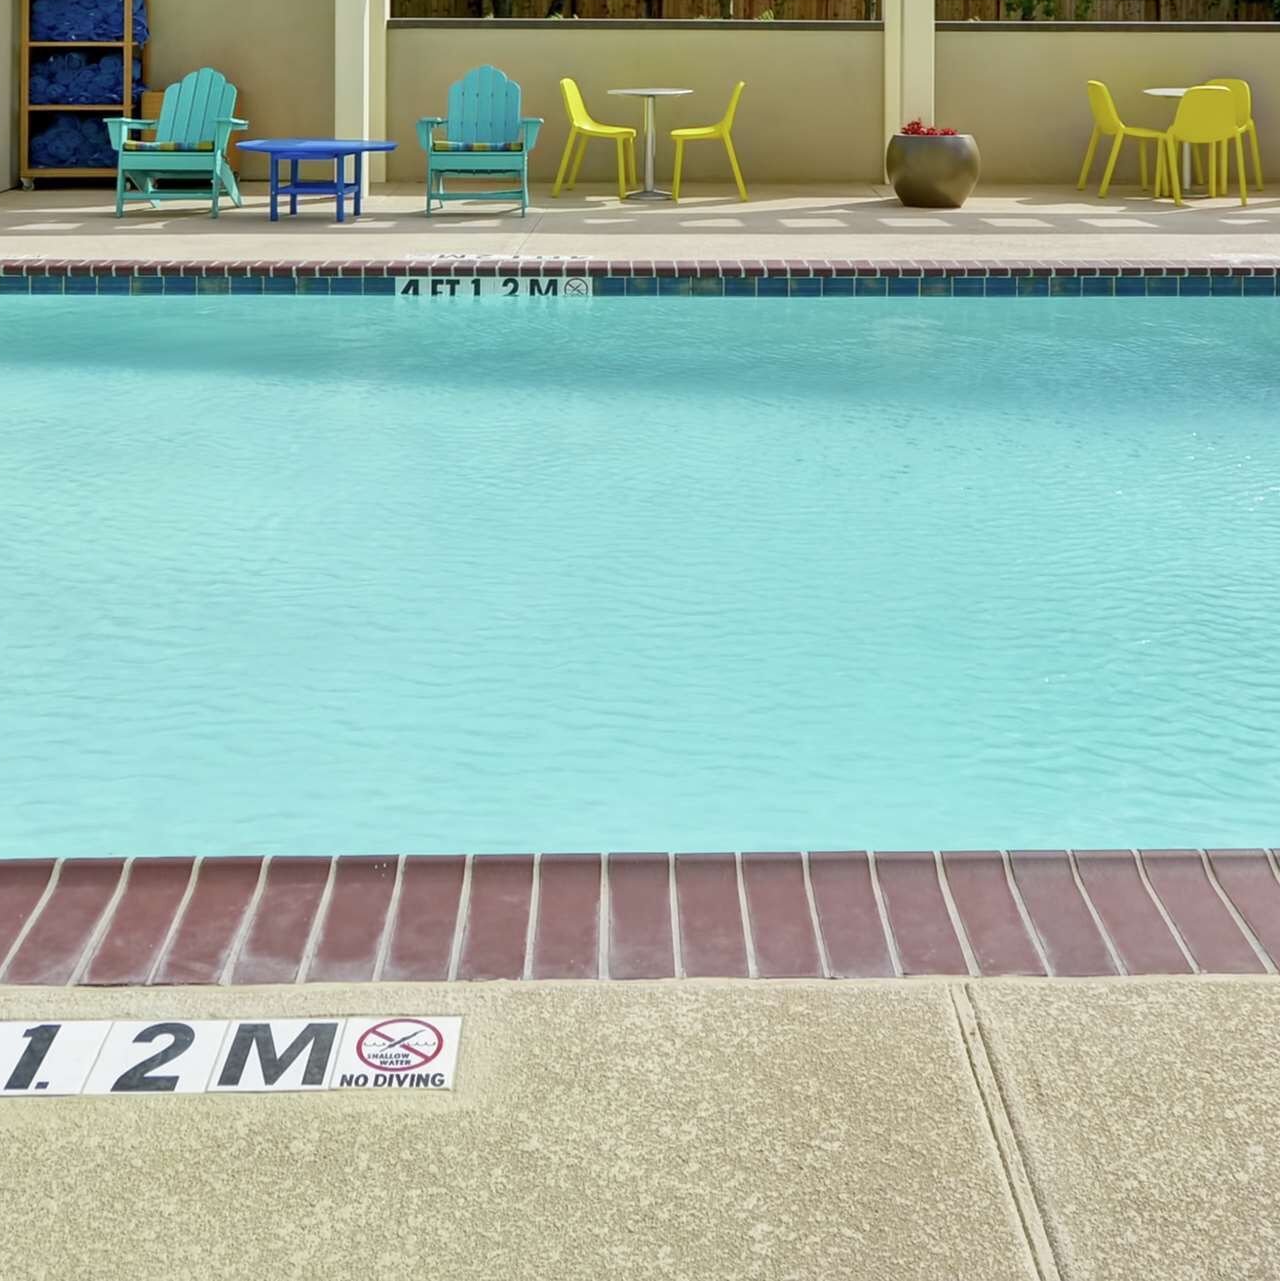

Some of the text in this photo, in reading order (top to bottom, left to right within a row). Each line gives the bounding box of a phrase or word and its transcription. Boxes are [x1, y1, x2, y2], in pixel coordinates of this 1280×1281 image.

[216, 1022, 339, 1087] M
[340, 1073, 446, 1088] NO DIVING
